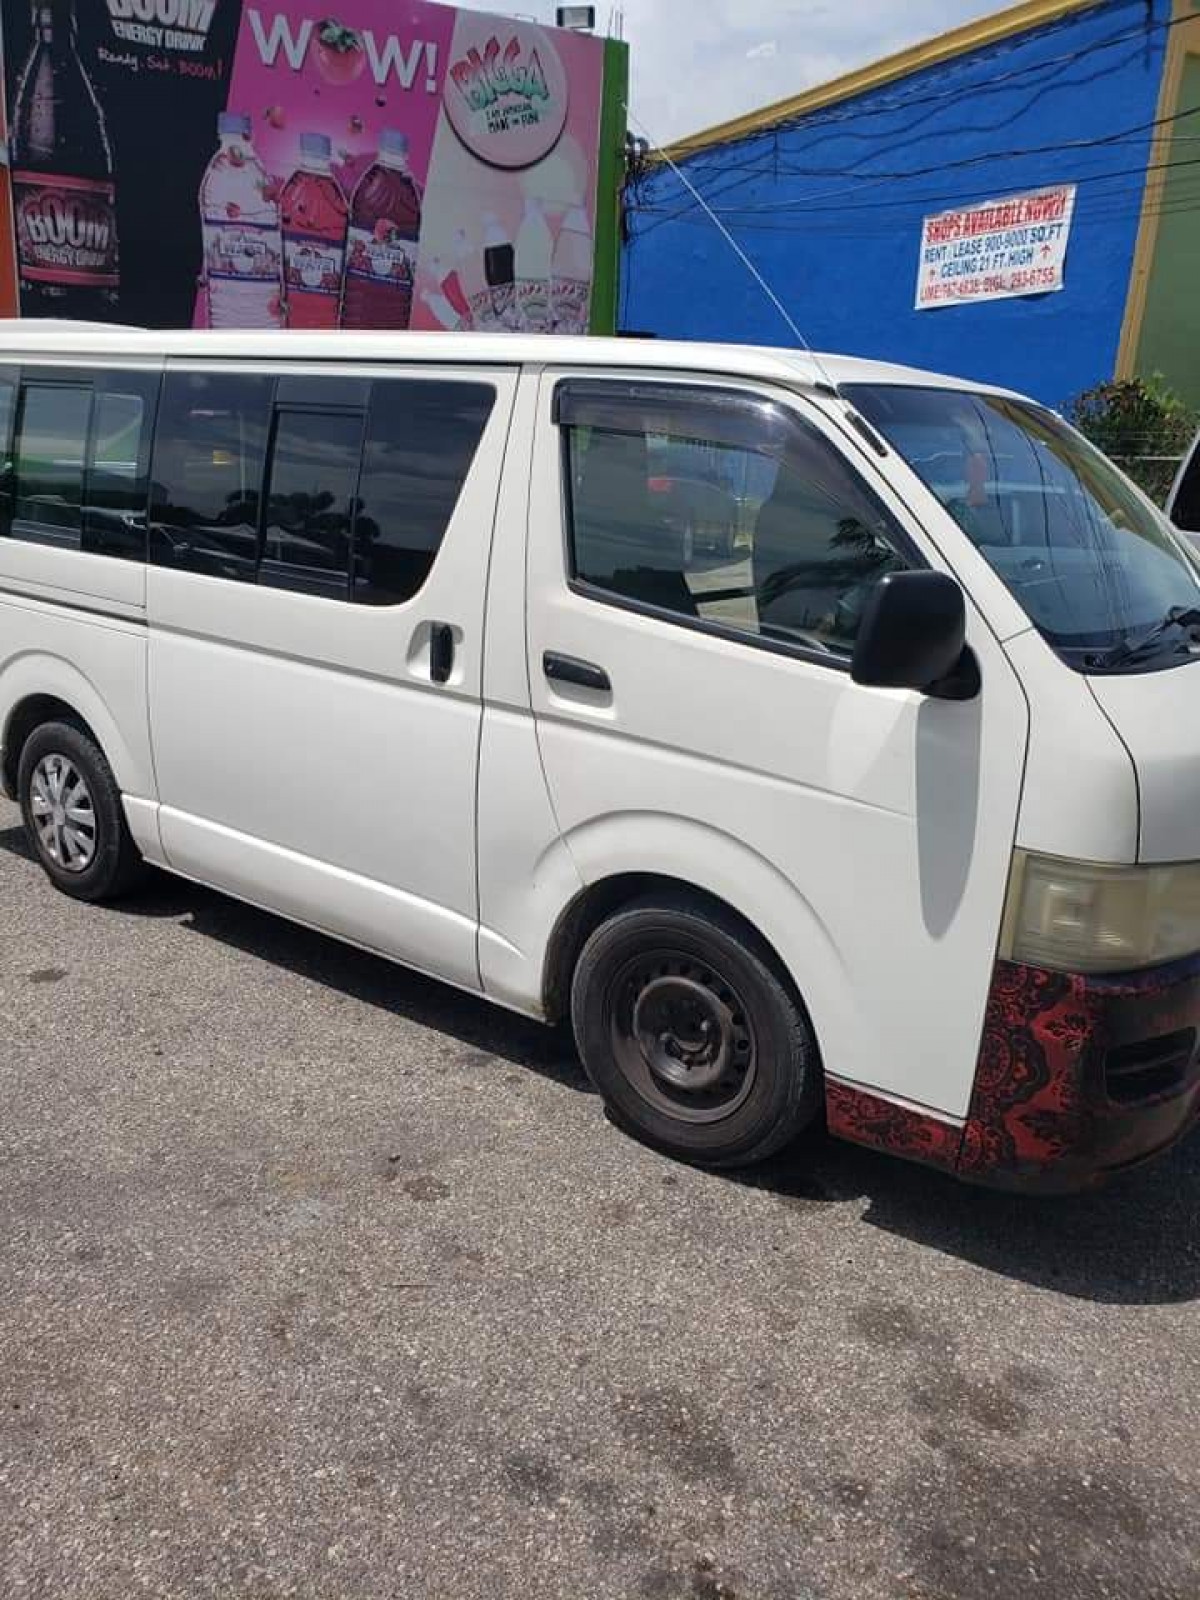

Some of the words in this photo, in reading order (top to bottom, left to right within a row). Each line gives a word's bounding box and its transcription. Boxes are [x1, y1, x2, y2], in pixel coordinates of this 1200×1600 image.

[111, 19, 163, 47] ENERGY
[164, 29, 207, 51] DRINK
[953, 237, 982, 258] LEASE
[941, 255, 977, 278] CEILING
